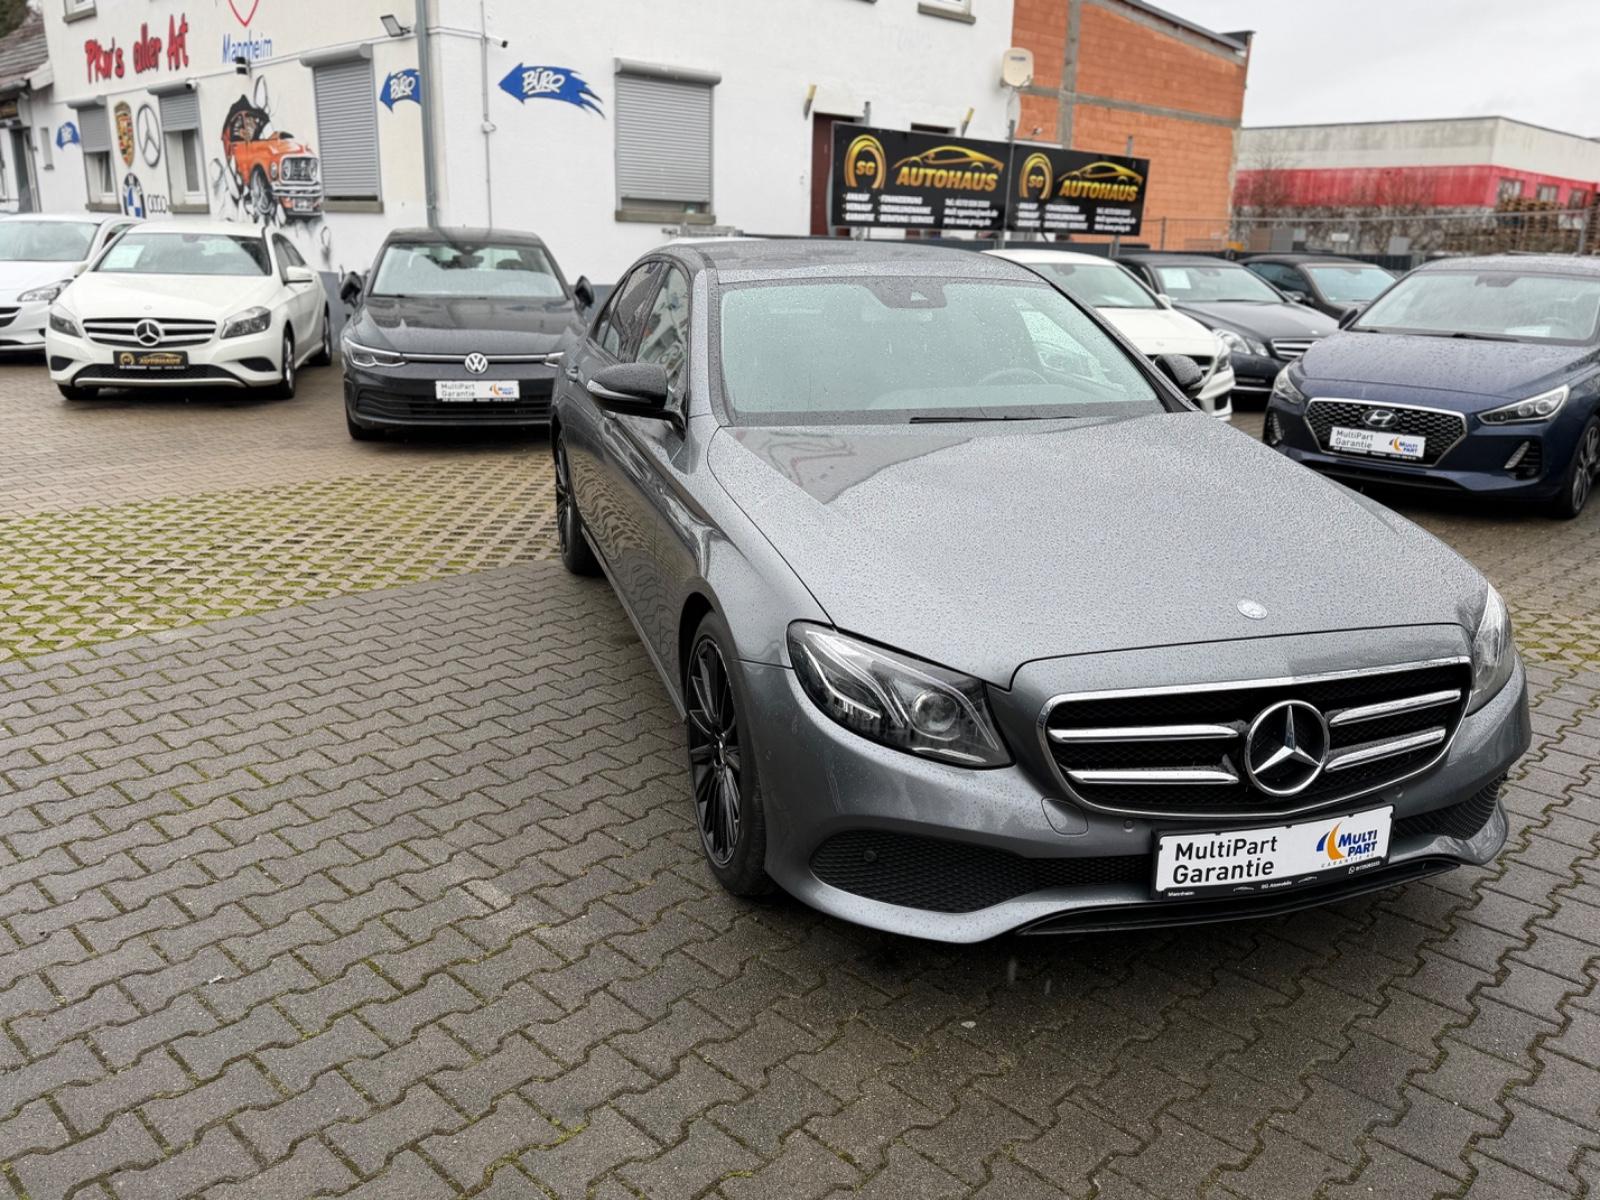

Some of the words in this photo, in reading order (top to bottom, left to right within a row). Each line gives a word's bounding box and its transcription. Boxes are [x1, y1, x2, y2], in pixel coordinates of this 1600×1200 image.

[167, 12, 189, 72] Art
[222, 30, 273, 64] Mannheim
[855, 160, 876, 176] SG
[896, 166, 998, 192] AUTOHAUS
[1059, 179, 1139, 202] AUTOHAUS
[1335, 438, 1373, 449] Garantie
[1336, 430, 1374, 441] MultiPart
[1174, 836, 1278, 862] MultiPart
[1338, 829, 1378, 848] MULTI
[1347, 841, 1378, 857] PART
[1173, 857, 1275, 885] Garantie
